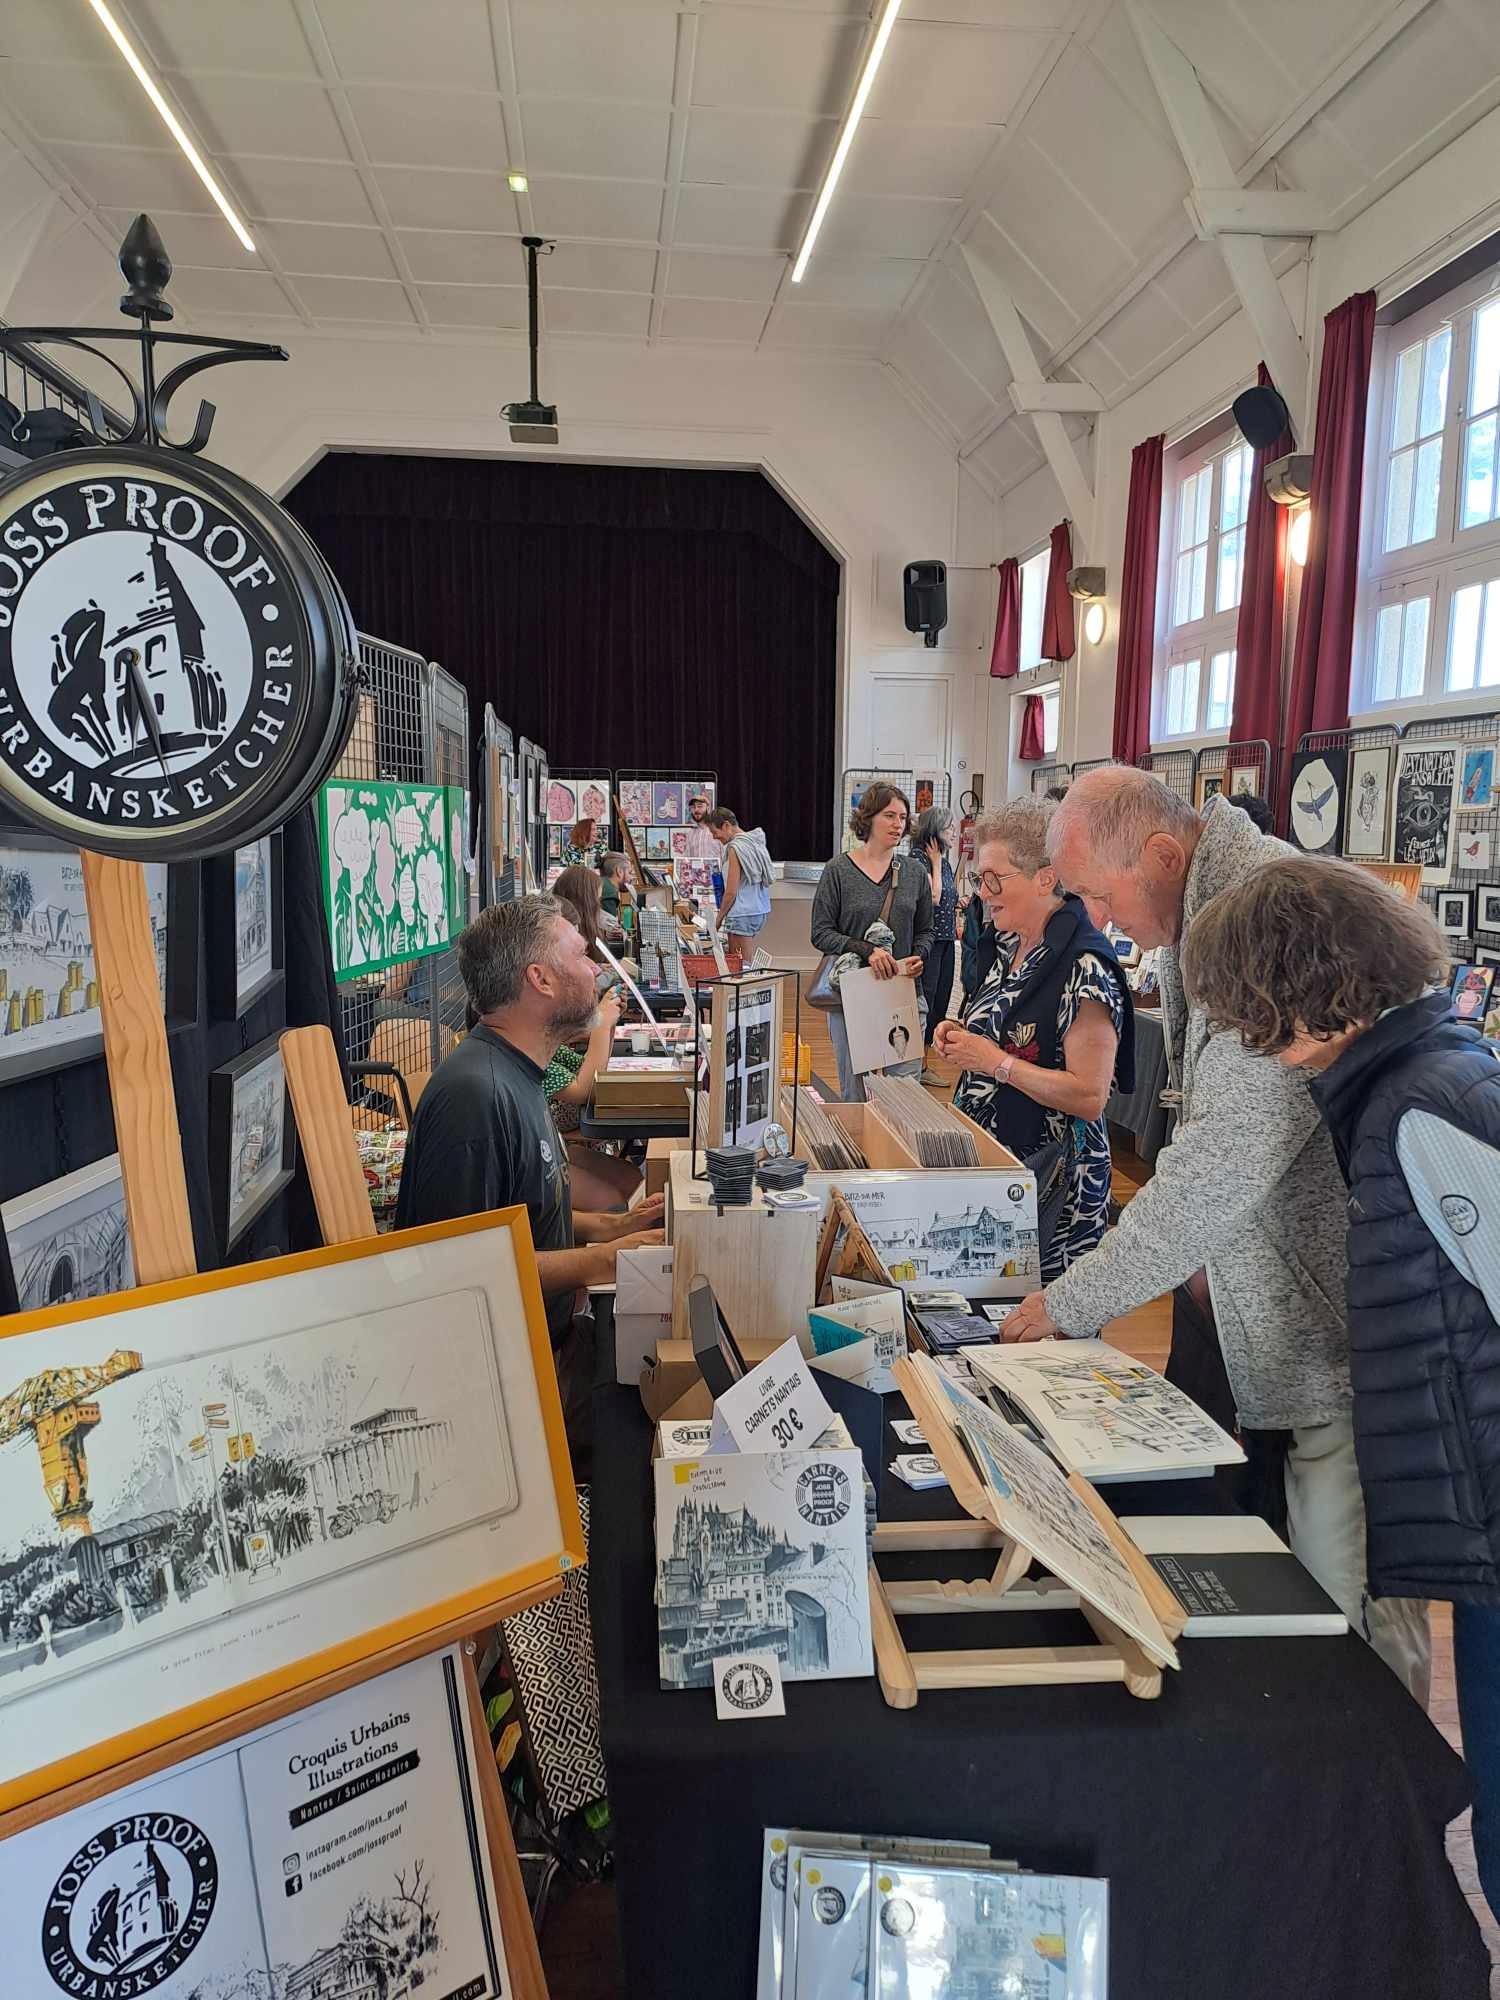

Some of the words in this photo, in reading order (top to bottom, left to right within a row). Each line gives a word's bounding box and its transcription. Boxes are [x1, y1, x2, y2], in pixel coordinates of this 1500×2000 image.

[79, 482, 277, 590] PROOF
[744, 1397, 777, 1434] CARNETS
[773, 1372, 802, 1406] NANTAIS
[758, 1376, 776, 1397] LIVRE
[771, 1417, 794, 1449] 30
[788, 1407, 804, 1431] €
[797, 1464, 848, 1487] CARNETS
[798, 1501, 850, 1526] NANTAIS
[288, 1738, 348, 1776] Croquis
[350, 1710, 412, 1747] Urbains
[306, 1740, 399, 1792] Illustrations
[300, 1799, 334, 1821] Nantes
[345, 1758, 410, 1799] Saint-Nazaire
[305, 1799, 409, 1862] instagram.com/joss_proof
[309, 1823, 403, 1882] facebook.com/jossproof
[51, 1837, 106, 1914] JOSS
[112, 1815, 207, 1855] PROOF
[50, 1878, 214, 1999] URBANSKETCHER
